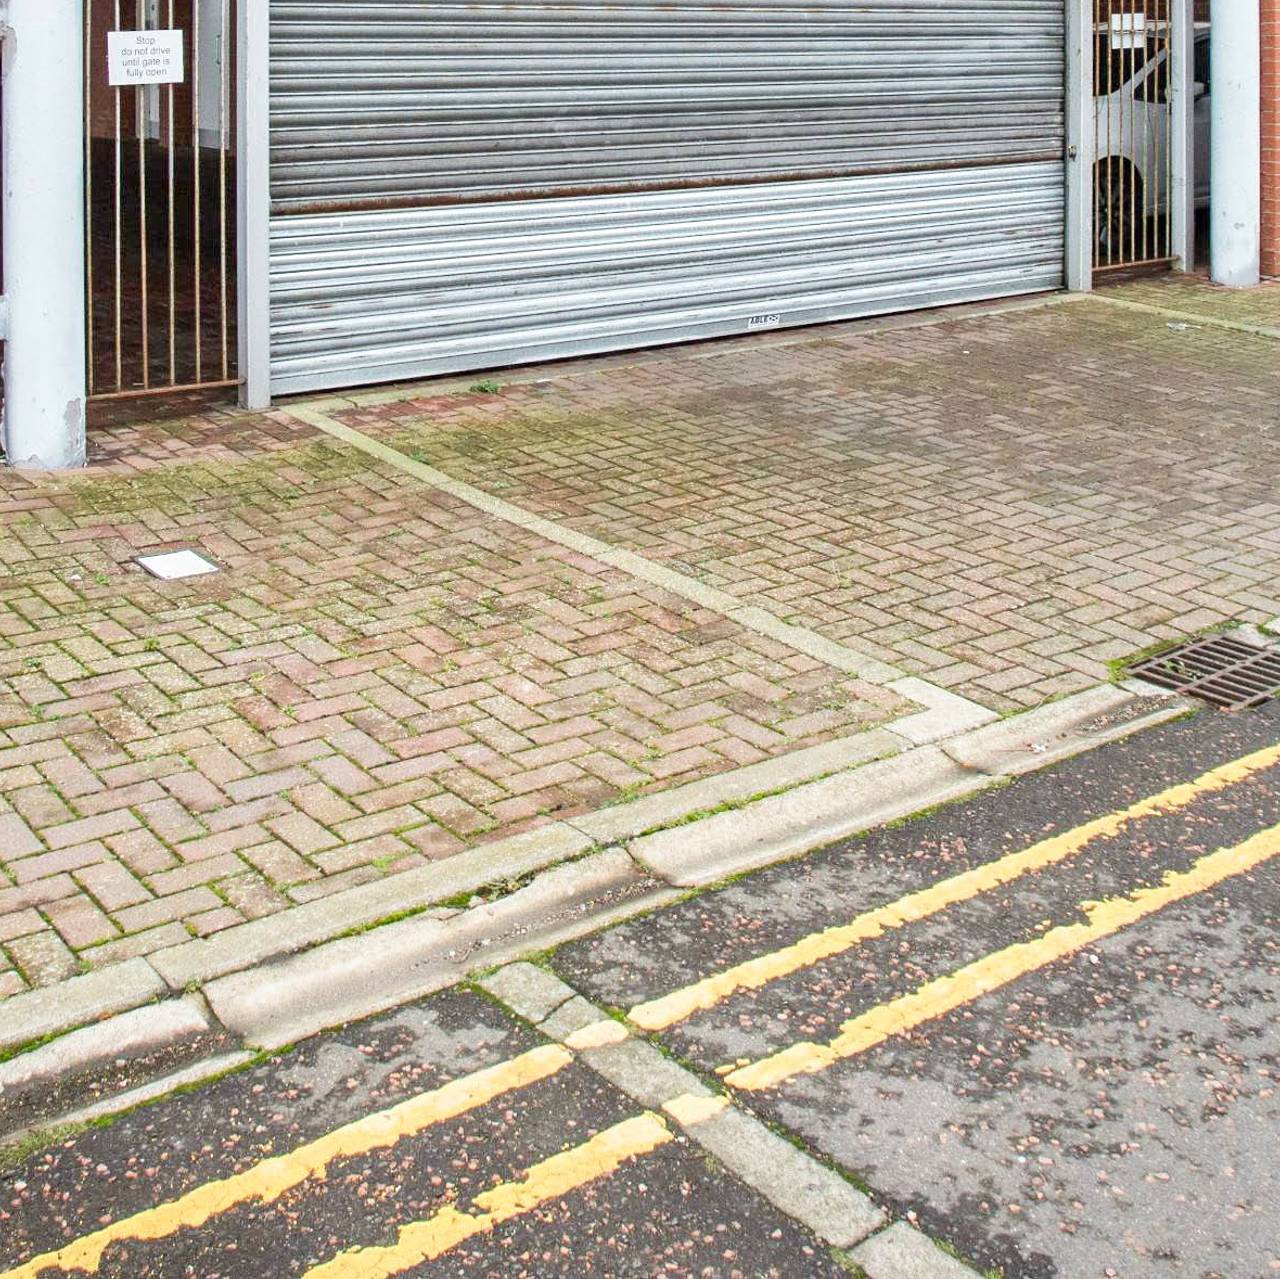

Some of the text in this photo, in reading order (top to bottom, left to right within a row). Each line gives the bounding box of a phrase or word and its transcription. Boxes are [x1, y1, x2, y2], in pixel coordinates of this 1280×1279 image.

[136, 36, 155, 46] Stop
[135, 47, 148, 56] not
[150, 46, 171, 55] drive
[122, 58, 140, 67] until
[143, 57, 161, 67] gate
[126, 67, 167, 78] fully open
